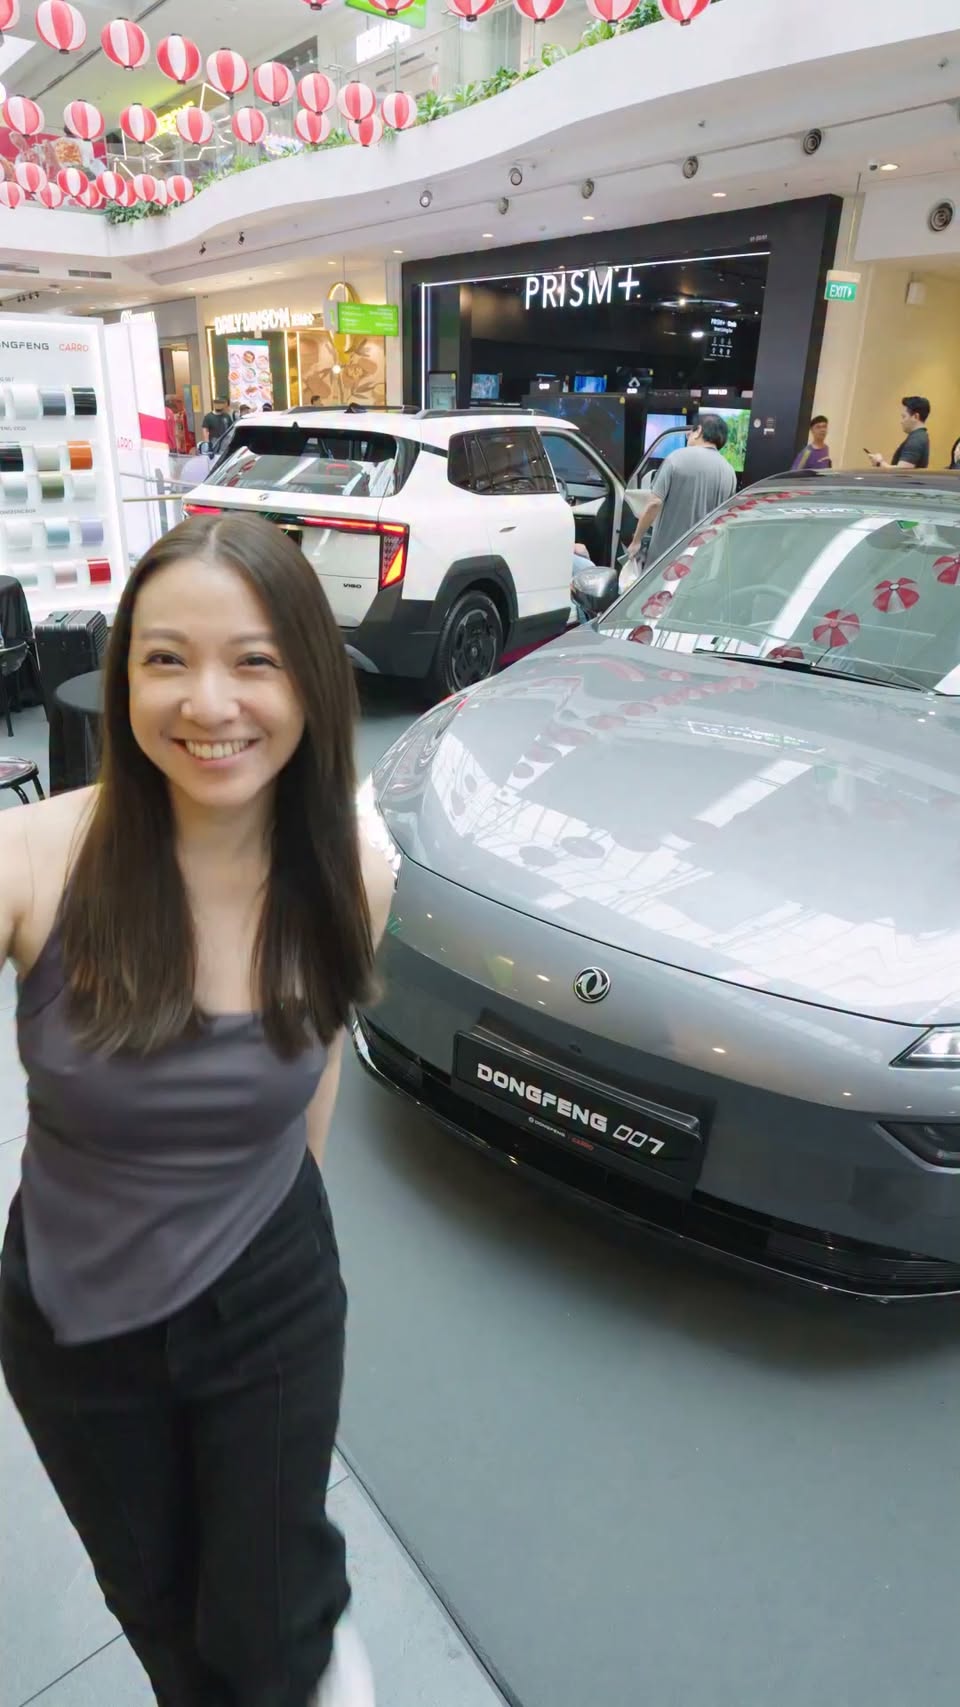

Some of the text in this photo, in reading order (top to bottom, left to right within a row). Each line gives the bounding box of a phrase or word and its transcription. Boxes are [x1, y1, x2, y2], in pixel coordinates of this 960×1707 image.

[525, 266, 640, 310] PRISM+
[831, 284, 849, 298] EXIT
[214, 312, 242, 336] DAILY
[0, 341, 89, 352] NGFENG CARRO
[477, 1063, 665, 1155] DONGFENG 007
